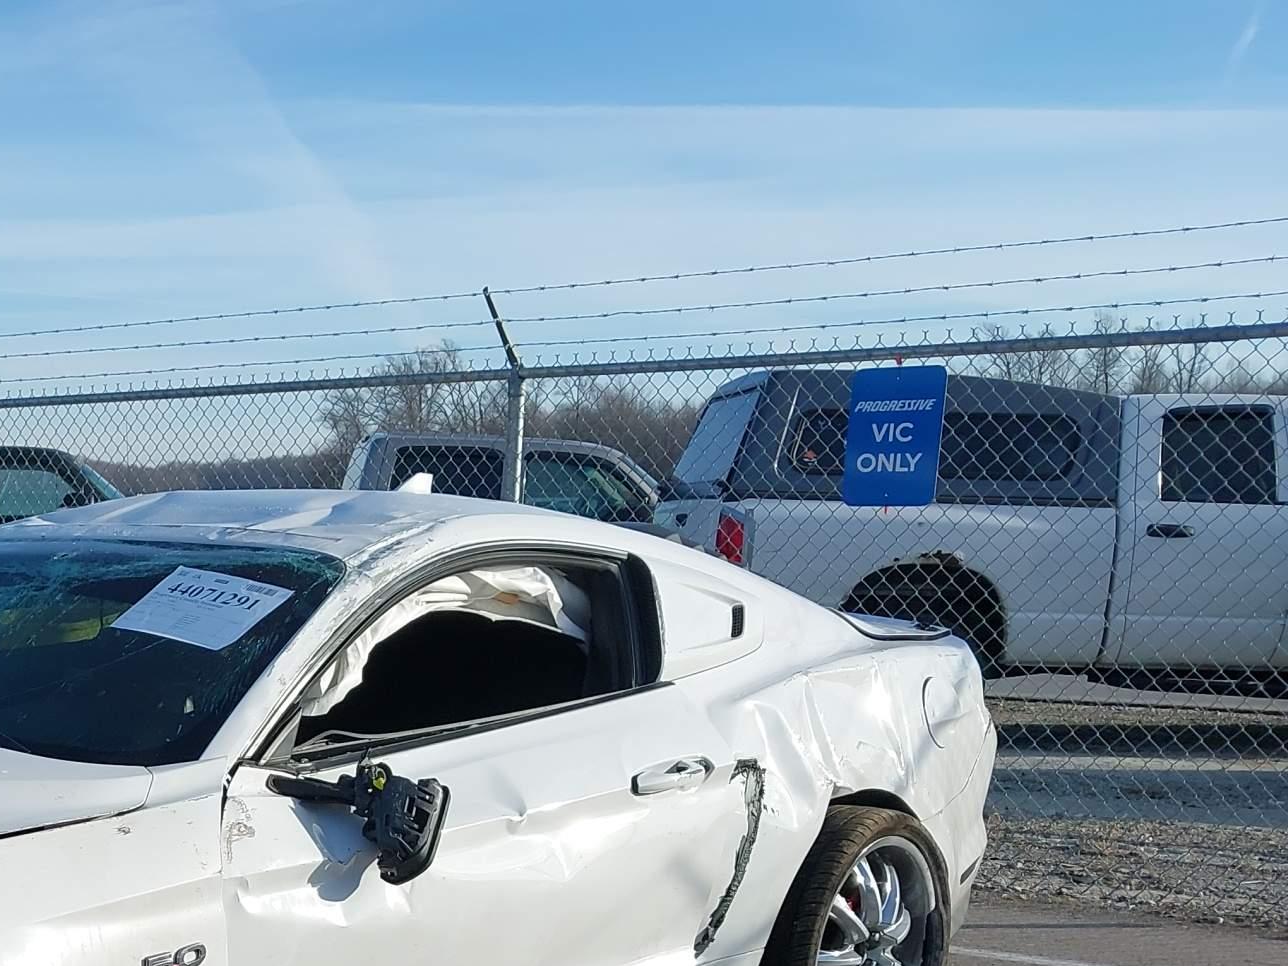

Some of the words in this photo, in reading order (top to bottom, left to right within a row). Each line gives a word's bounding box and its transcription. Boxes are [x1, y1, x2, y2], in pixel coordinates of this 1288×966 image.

[855, 399, 936, 412] PROGRESSIVE
[872, 422, 914, 442] VIC
[856, 453, 922, 473] ONLY
[167, 582, 260, 611] 44071291
